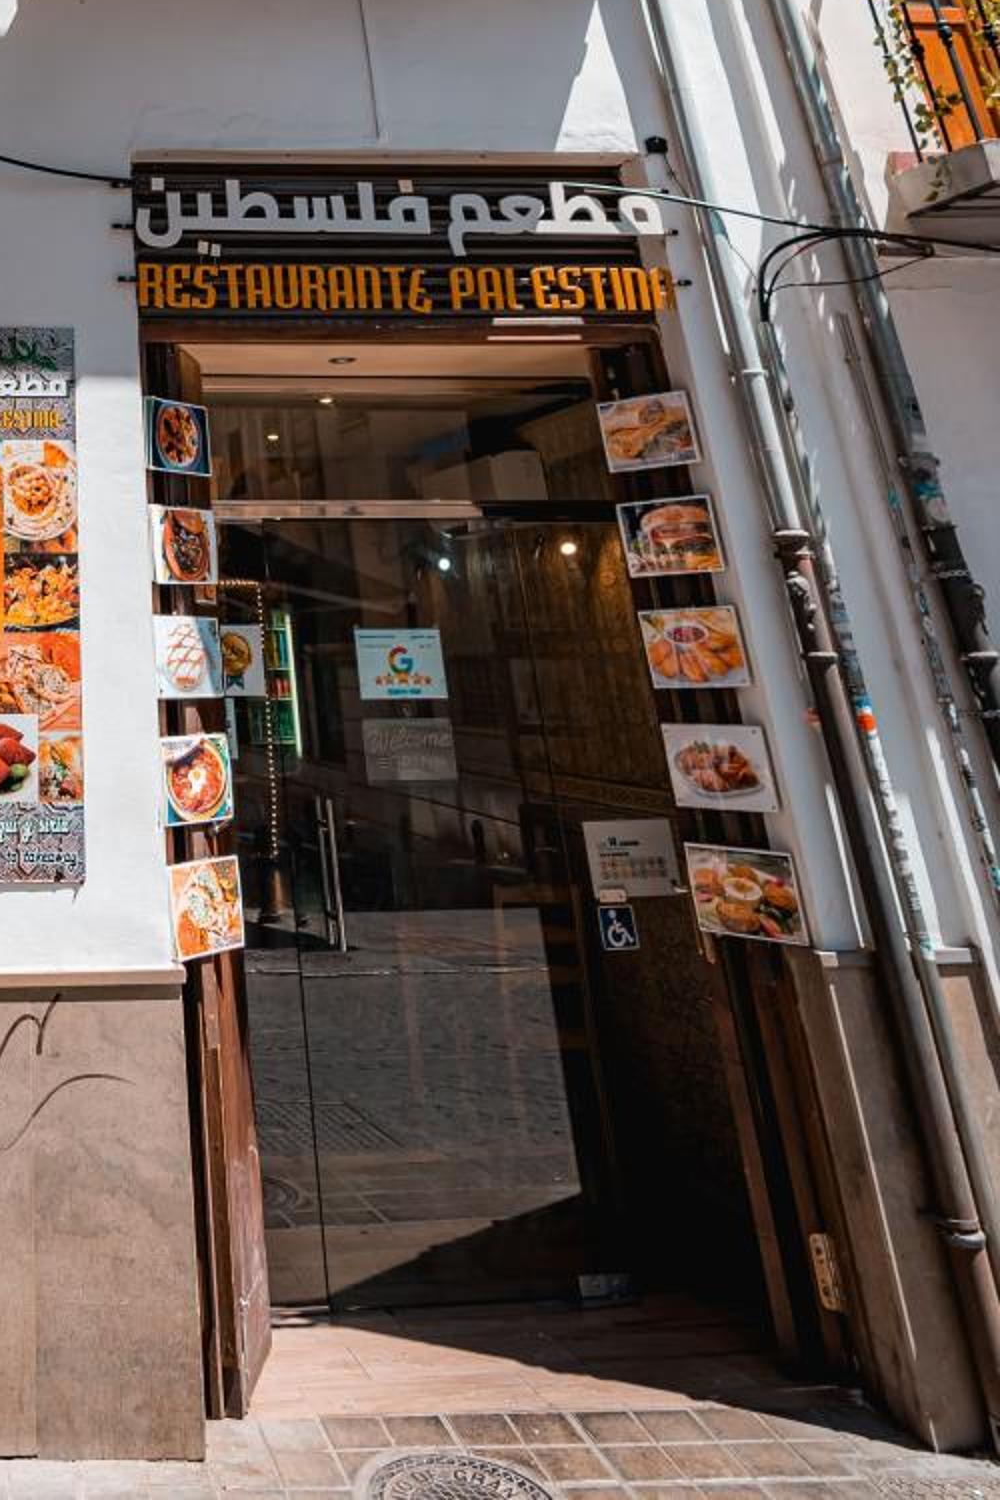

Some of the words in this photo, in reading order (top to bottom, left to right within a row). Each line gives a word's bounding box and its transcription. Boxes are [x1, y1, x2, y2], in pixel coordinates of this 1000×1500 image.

[135, 177, 432, 258] فلسطين
[447, 181, 666, 257] مطعم
[137, 262, 433, 314] RESTAURANTE
[451, 265, 676, 312] PALESTINA
